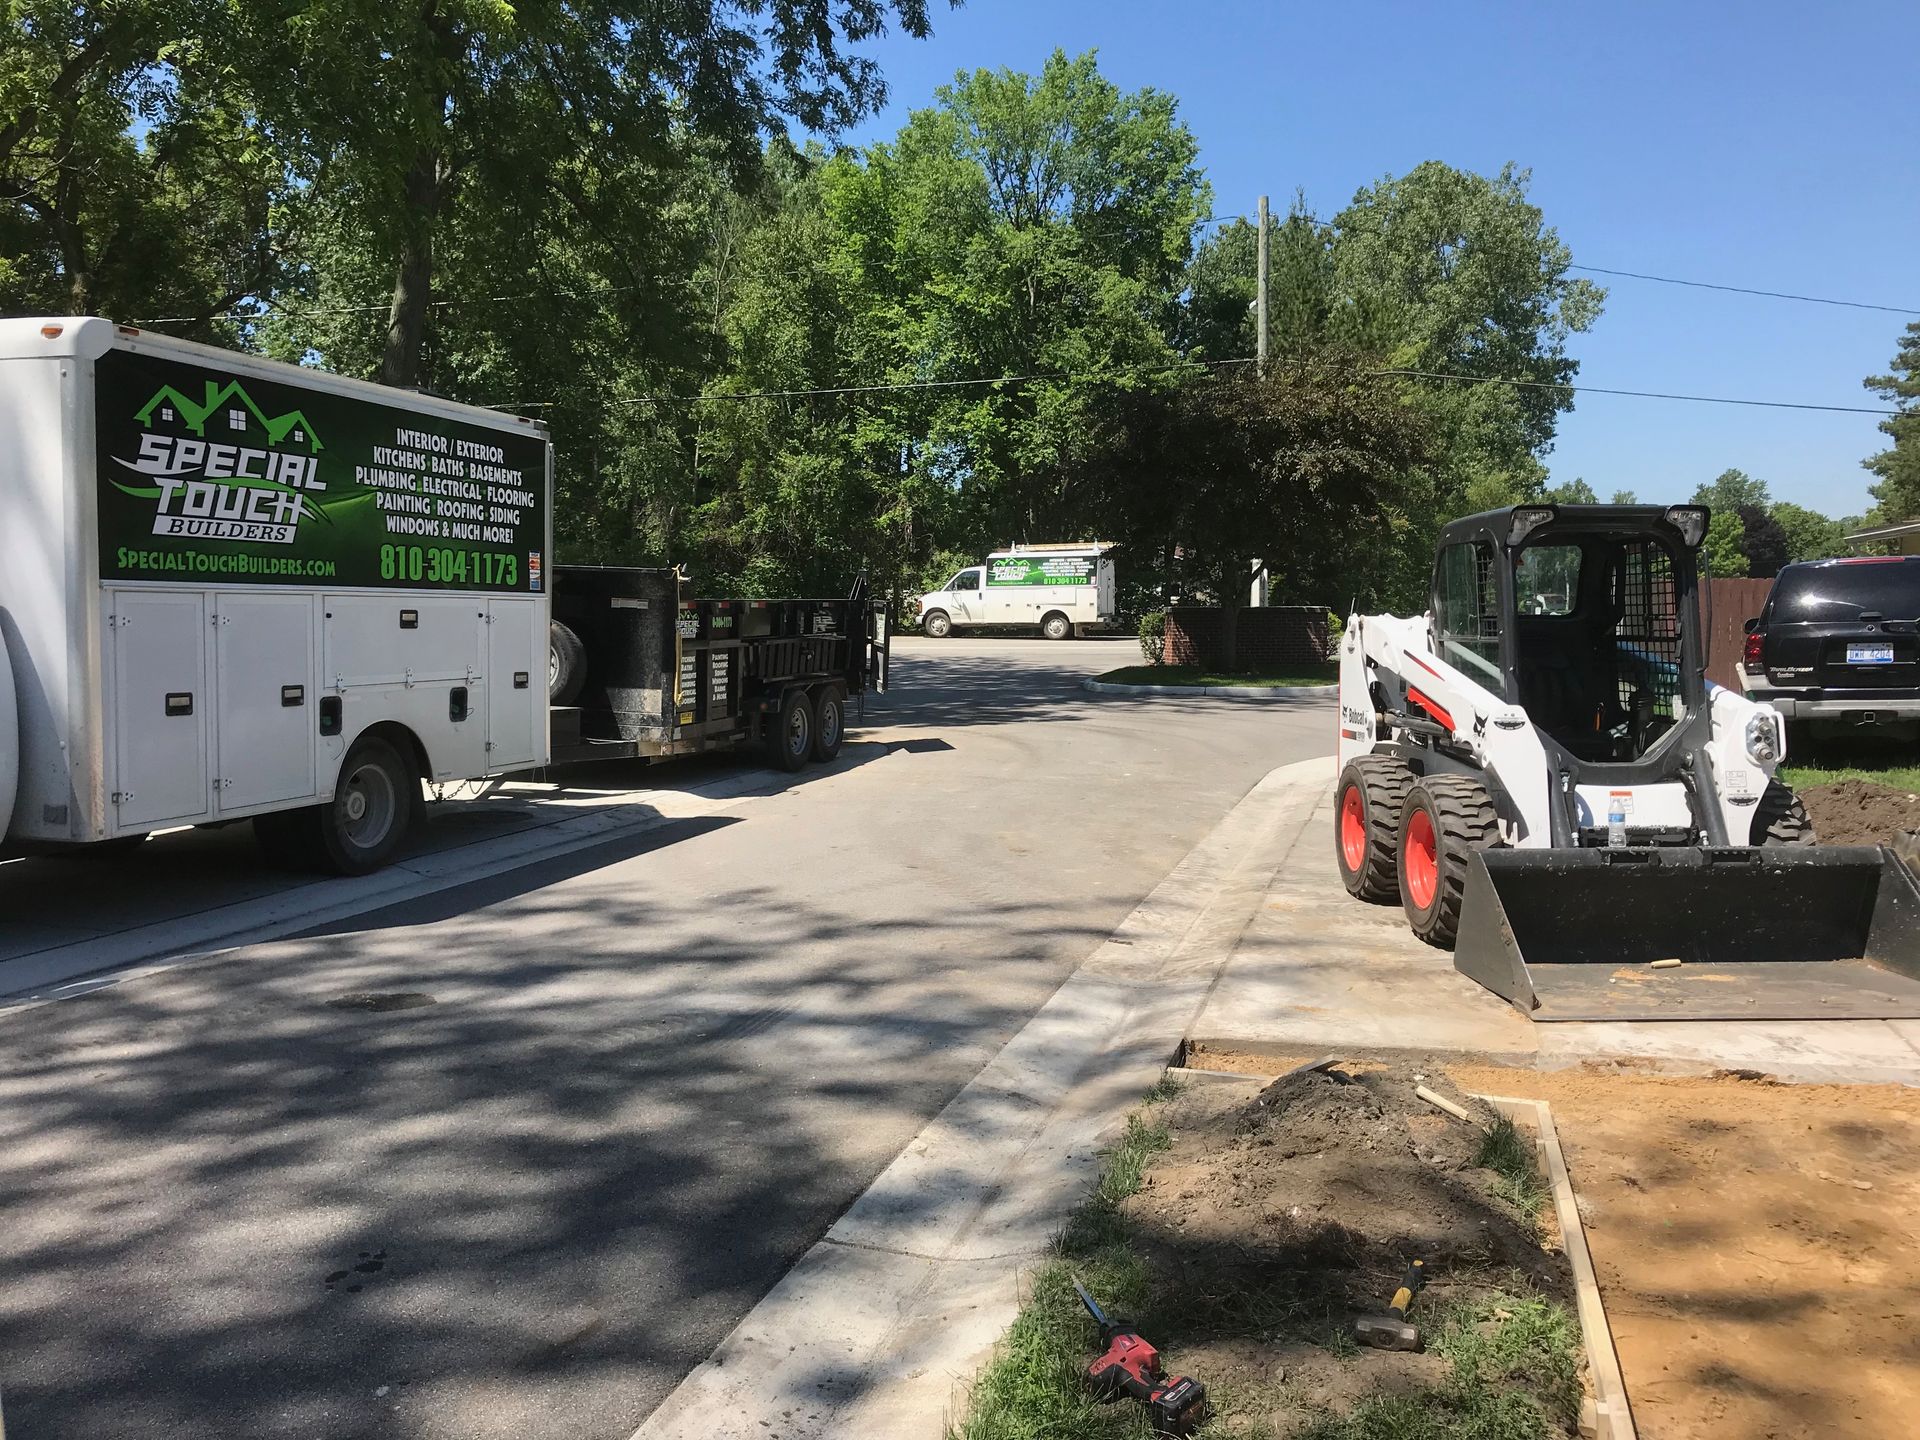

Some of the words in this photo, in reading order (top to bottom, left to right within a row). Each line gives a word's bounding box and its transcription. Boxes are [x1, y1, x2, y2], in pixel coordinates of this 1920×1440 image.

[136, 433, 327, 491] SPECIAL
[373, 446, 426, 471] KITCHENS
[431, 456, 464, 477] BATHS
[469, 464, 522, 487] BASEMENTS
[396, 428, 448, 454] INTERIOR
[456, 440, 504, 464] EXTERIOR
[153, 477, 305, 524] TOUCH
[355, 466, 416, 492] PLUMBING
[422, 476, 482, 501] ELECTRICAL
[487, 486, 535, 508] FLOORING
[376, 491, 430, 515] PAINTING
[437, 500, 484, 521] ROOFING
[489, 508, 520, 526] SIDING
[167, 518, 289, 541] BUILDERS
[386, 515, 439, 537] WINDOWS
[442, 521, 450, 538] &
[452, 523, 480, 541] MUCH
[483, 526, 514, 544] MORE!
[380, 544, 518, 586] 810-304-1173
